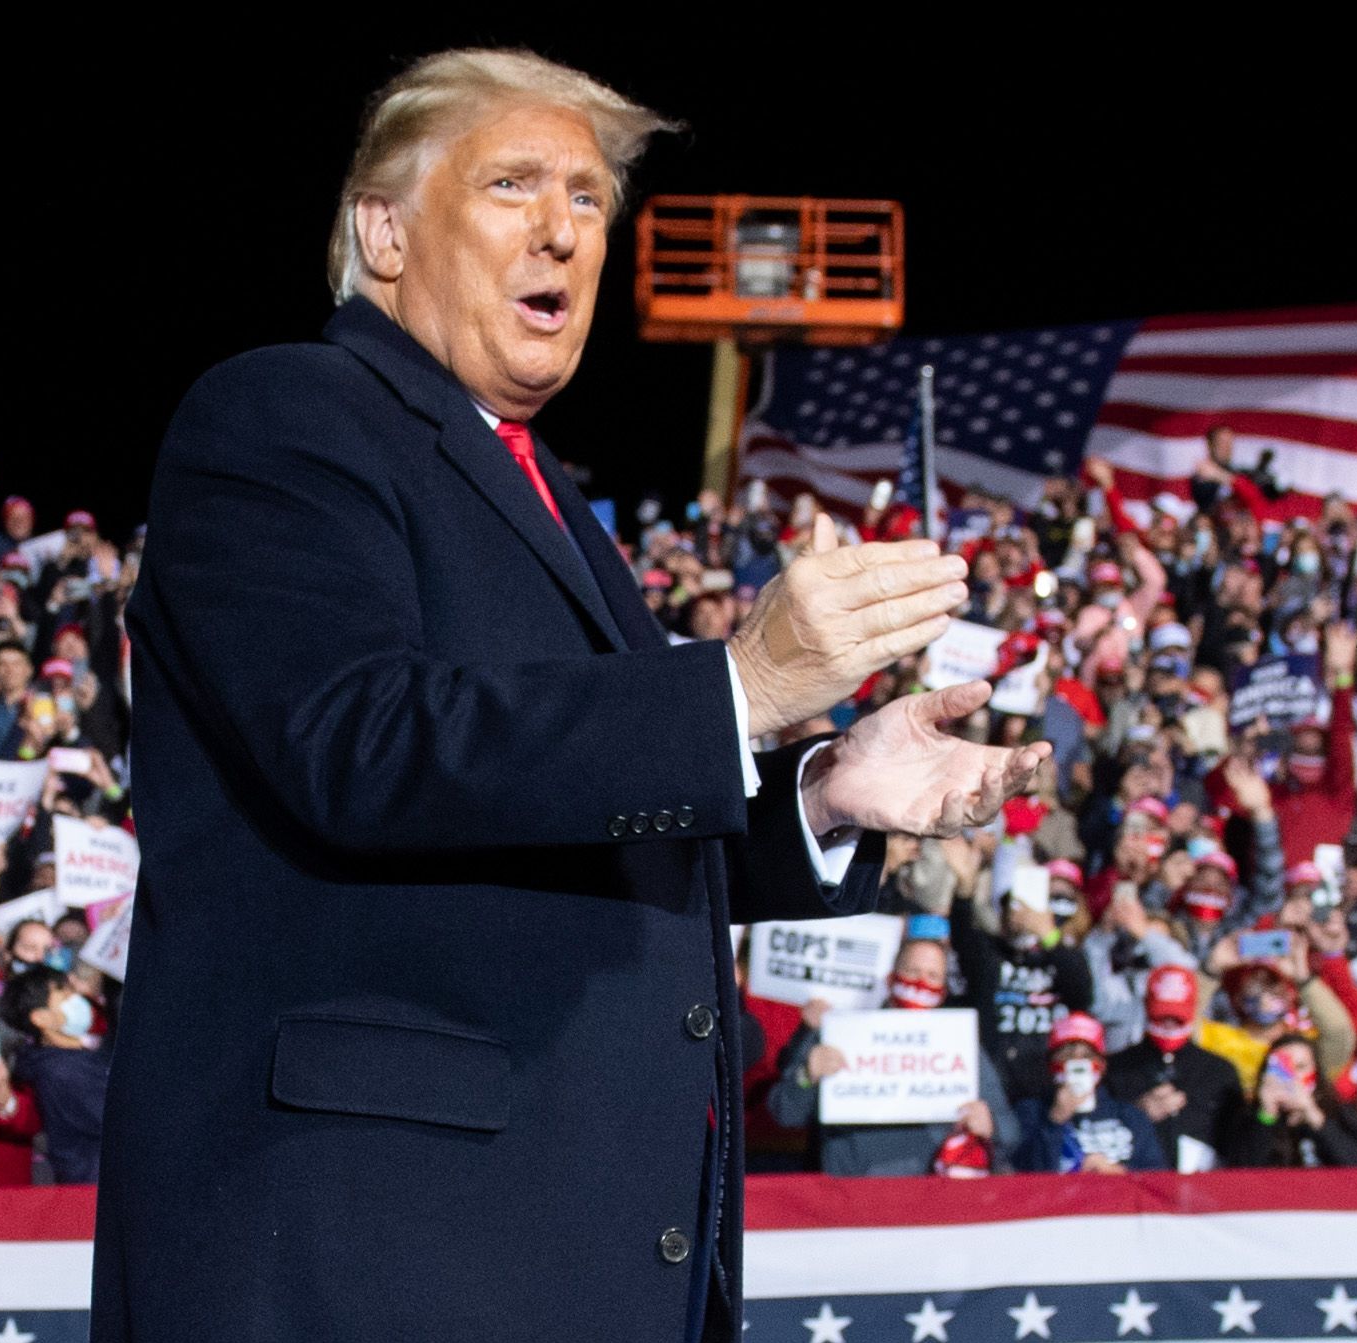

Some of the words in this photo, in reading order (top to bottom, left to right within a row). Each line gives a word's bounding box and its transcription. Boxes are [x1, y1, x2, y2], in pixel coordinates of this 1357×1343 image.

[769, 929, 830, 960] COPS
[872, 1031, 930, 1046] MAKE
[832, 1080, 900, 1098] GREAT
[907, 1080, 970, 1097] AGAIN
